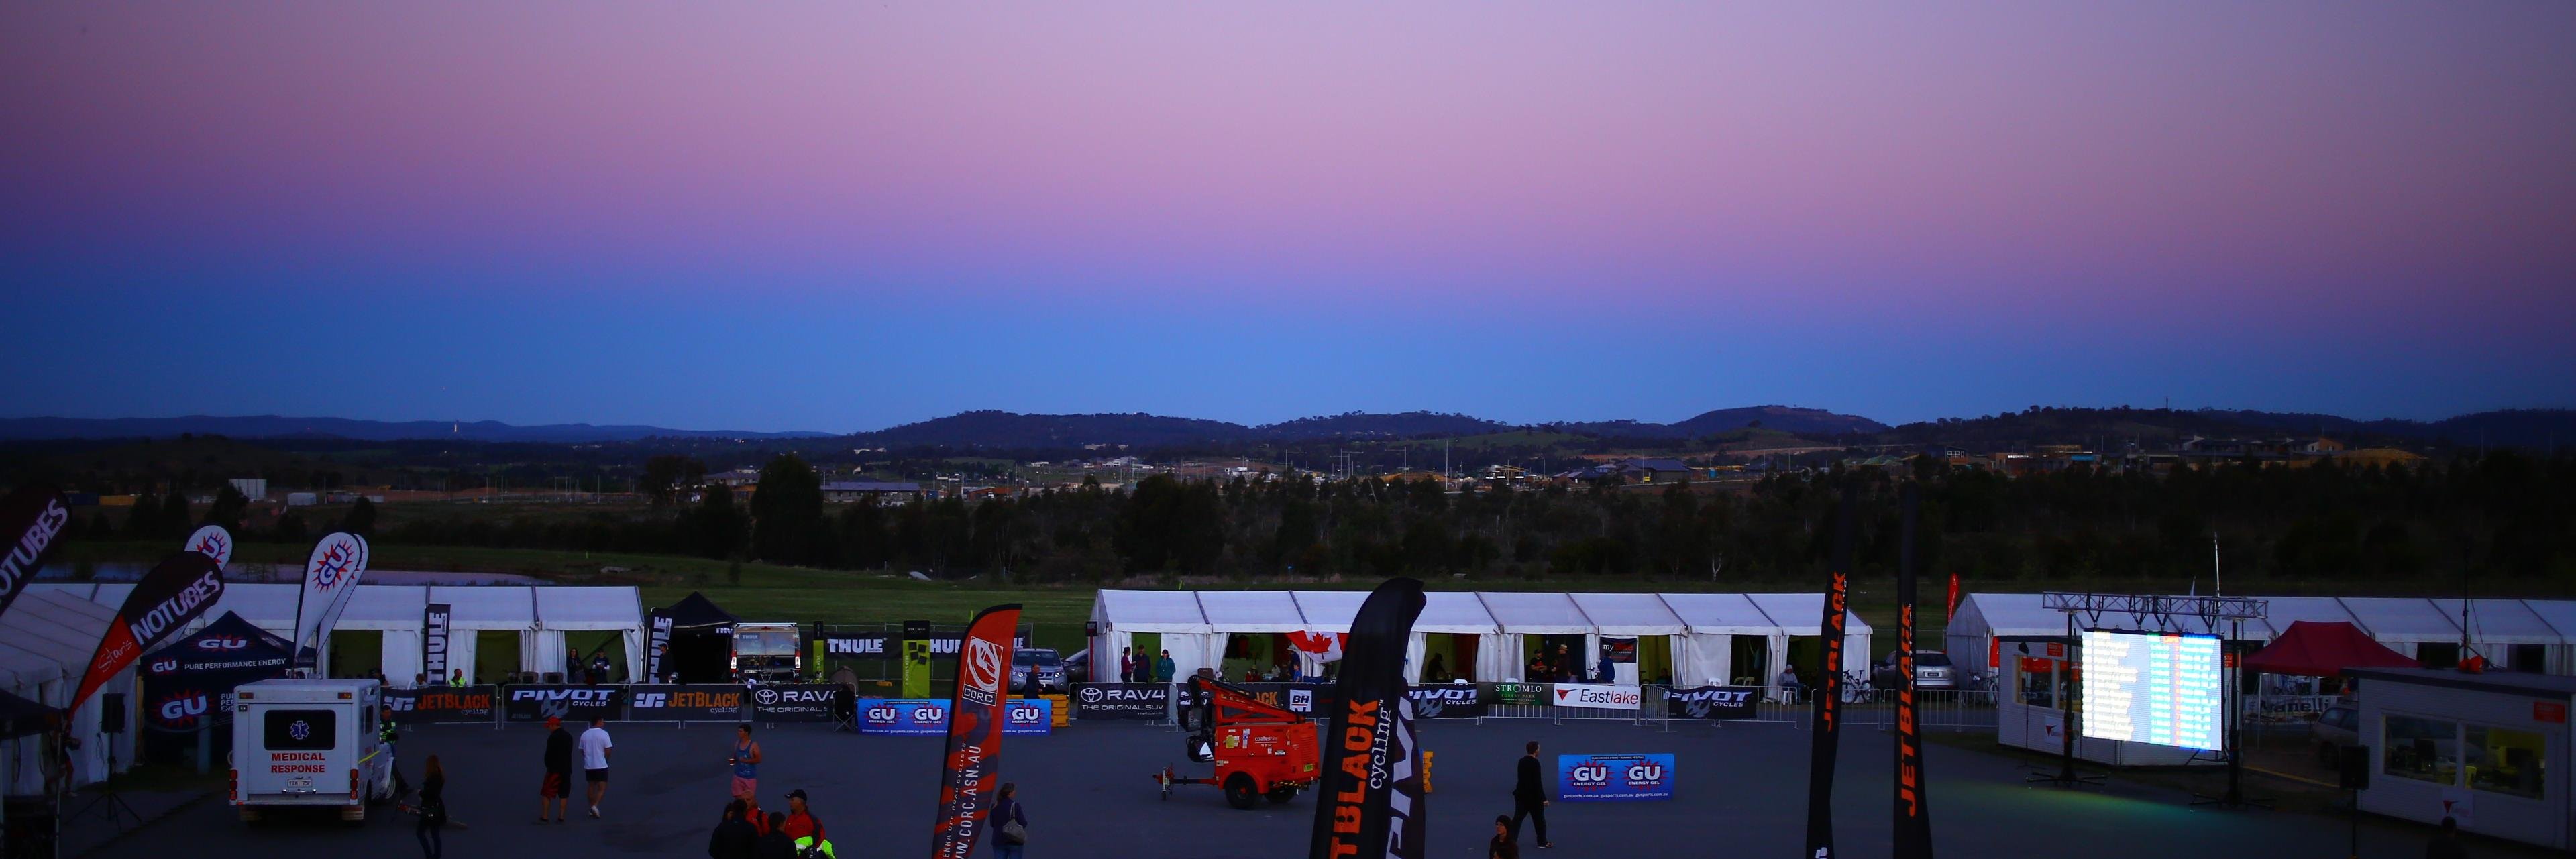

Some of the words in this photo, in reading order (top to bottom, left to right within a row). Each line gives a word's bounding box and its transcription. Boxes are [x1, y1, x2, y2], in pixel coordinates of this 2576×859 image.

[203, 537, 221, 559] U
[319, 544, 348, 585] GU
[131, 571, 221, 645] NOTUBES
[198, 639, 248, 648] GU
[427, 613, 447, 685] THULE
[827, 638, 883, 654] THULE
[152, 660, 177, 673] GU
[205, 660, 257, 669] PERFORMANCE
[258, 658, 286, 666] ENERGY
[512, 689, 616, 701] PIVOT
[964, 688, 994, 703] CORC
[1107, 689, 1165, 700] RAV4
[1495, 684, 1542, 693] STROMLO
[417, 693, 492, 711] JETBLACK
[668, 691, 741, 707] JETBLACK
[1292, 695, 1309, 704] BH
[1580, 689, 1638, 705] Eastlake
[161, 695, 208, 720] GU
[869, 708, 896, 720] GU
[914, 708, 942, 720] GU
[1012, 708, 1039, 720] GU
[1370, 707, 1391, 789] cycling
[271, 765, 325, 773] RESPONSE
[1574, 766, 1607, 781] GU
[1629, 766, 1661, 781] GU
